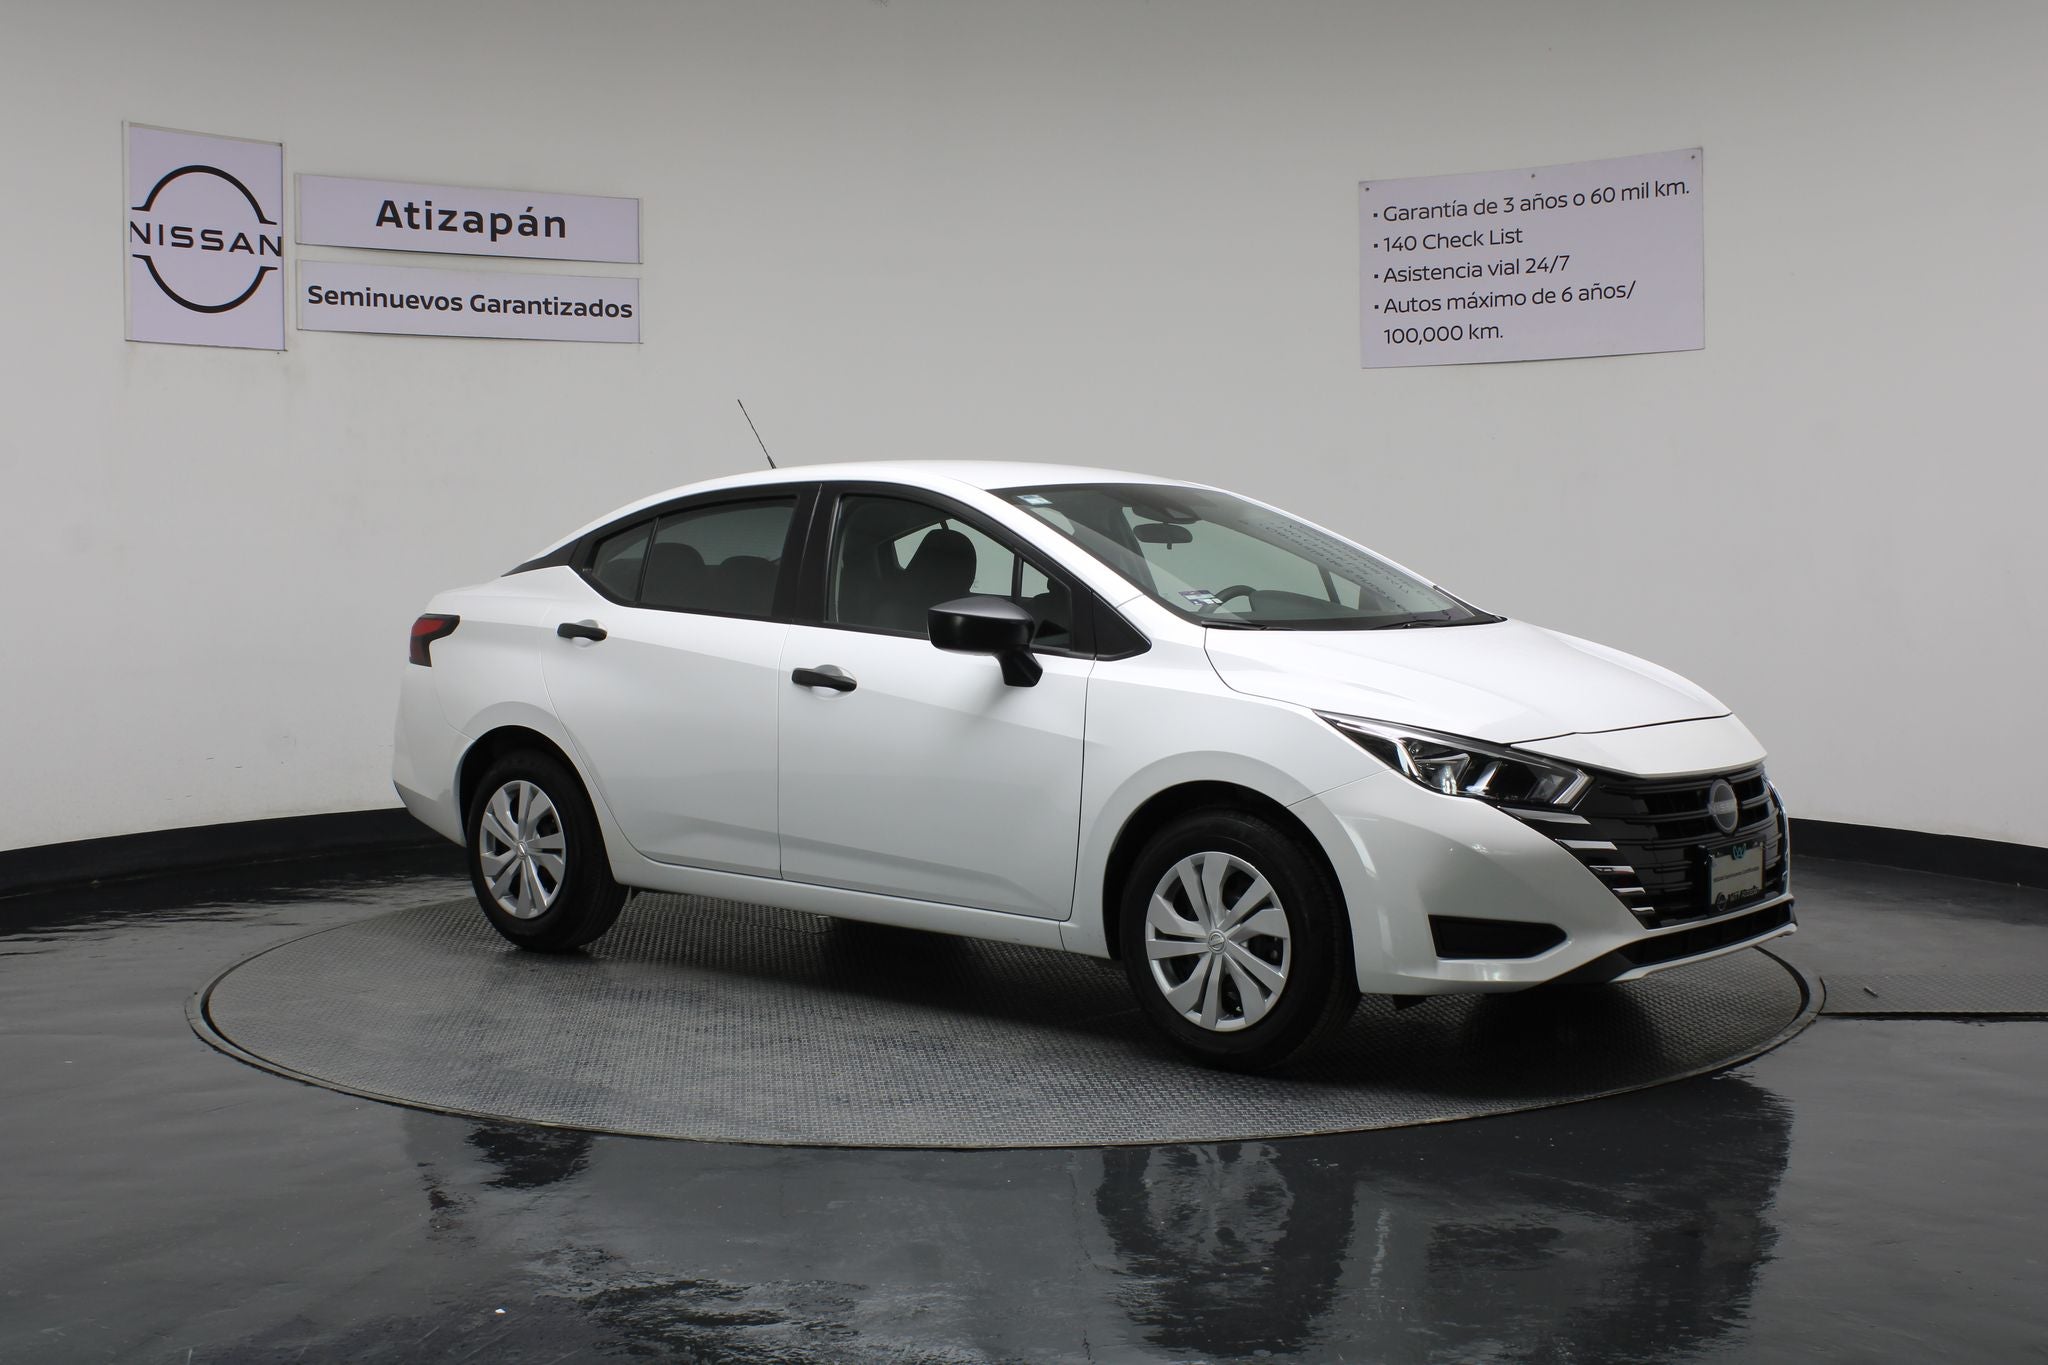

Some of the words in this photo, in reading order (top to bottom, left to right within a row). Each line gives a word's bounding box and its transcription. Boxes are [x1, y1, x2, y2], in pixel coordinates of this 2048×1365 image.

[1383, 199, 1468, 222] Garantía
[1473, 198, 1498, 216] de
[1503, 196, 1515, 214] 3
[1519, 192, 1569, 212] años
[1572, 192, 1586, 207] o
[1590, 186, 1616, 205] 60
[1621, 181, 1650, 202] mil
[1654, 179, 1690, 198] km.
[375, 199, 566, 243] Atizapán
[129, 220, 283, 258] NISSAN
[1383, 235, 1418, 253] 140
[1422, 229, 1485, 250] Check
[1489, 227, 1524, 246] List
[1383, 262, 1483, 284] Asistencia
[1487, 257, 1520, 277] vial
[1524, 254, 1571, 274] 24/7
[307, 285, 463, 312] Seminuevos
[469, 294, 633, 319] Garantizados
[1383, 297, 1442, 314] Autos
[1446, 290, 1527, 311] máximo
[1531, 287, 1557, 305] de
[1561, 286, 1573, 303] 6
[1578, 279, 1637, 302] años/
[1383, 325, 1464, 346] 100,000
[1468, 323, 1503, 341] km.
